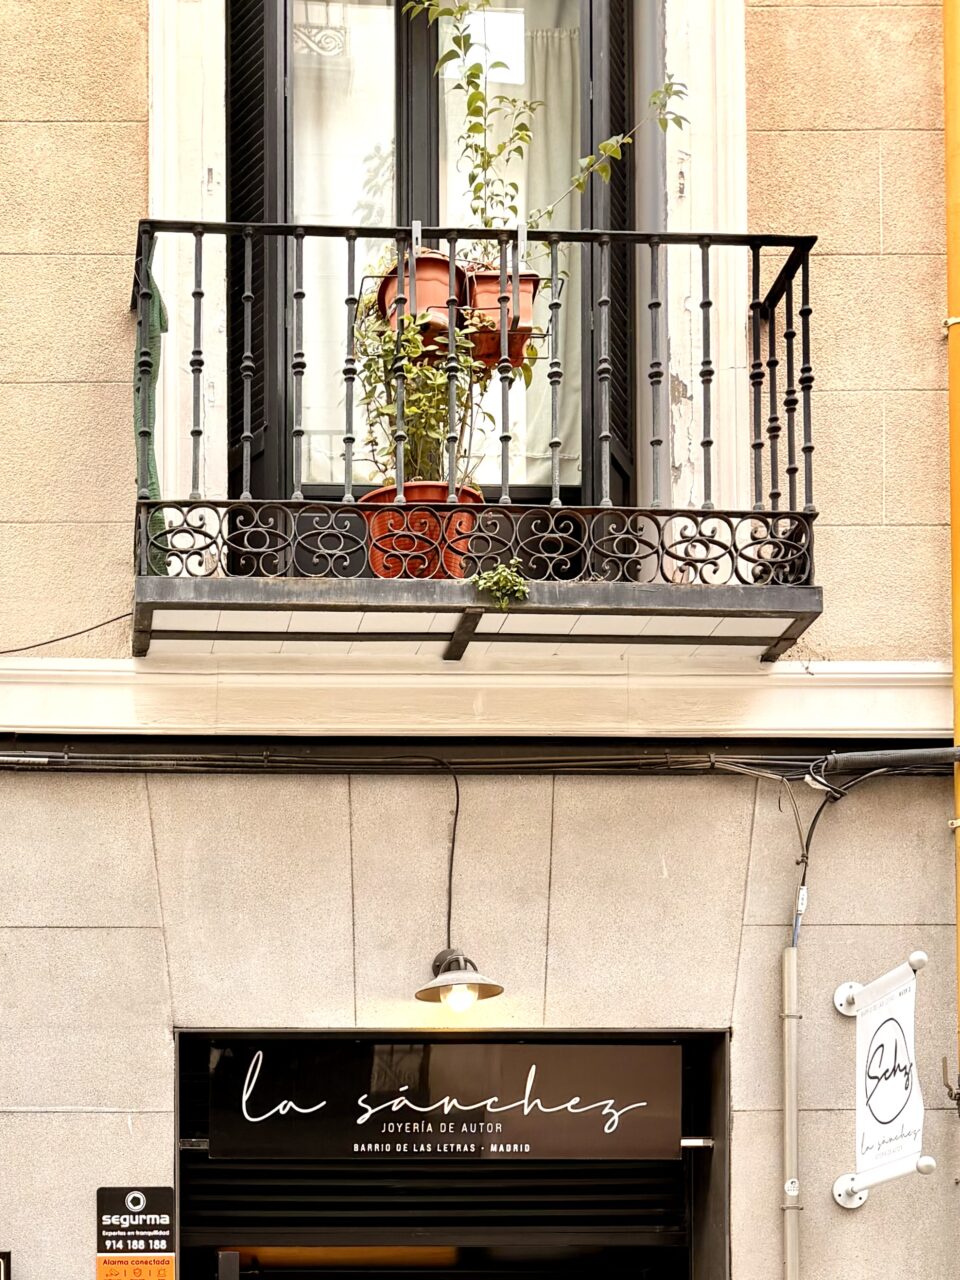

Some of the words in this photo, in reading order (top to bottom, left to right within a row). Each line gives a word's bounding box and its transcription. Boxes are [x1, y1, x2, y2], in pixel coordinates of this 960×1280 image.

[241, 1050, 327, 1122] la
[356, 1064, 647, 1133] sánchez
[381, 1121, 433, 1133] JOYERÍA
[440, 1122, 455, 1133] DE
[461, 1122, 502, 1133] AUTOR
[353, 1143, 391, 1152] BARRIO
[396, 1143, 408, 1152] DE
[413, 1143, 432, 1153] LAS
[437, 1143, 476, 1153] LETRAS
[490, 1143, 531, 1153] MADRID
[102, 1214, 170, 1228] segurma
[105, 1240, 124, 1250] 914
[127, 1240, 145, 1250] 188
[149, 1240, 167, 1250] 188
